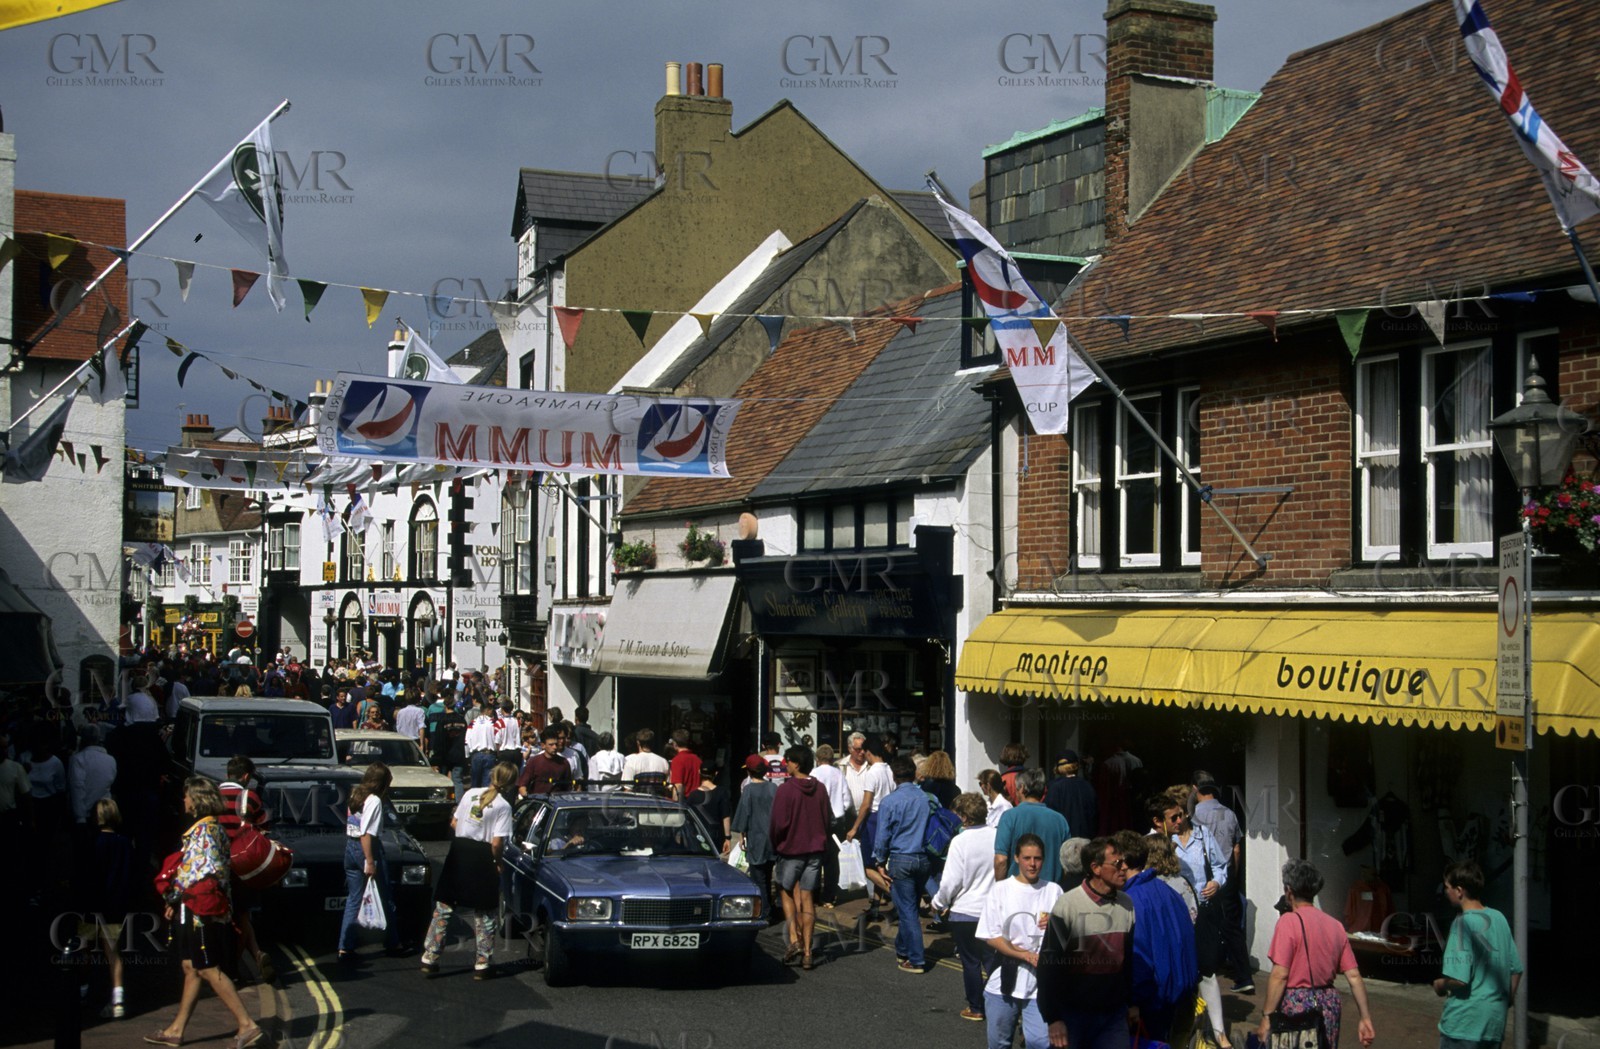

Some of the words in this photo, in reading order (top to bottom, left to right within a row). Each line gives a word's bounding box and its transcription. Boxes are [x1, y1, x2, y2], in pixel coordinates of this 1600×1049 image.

[1026, 402, 1058, 414] CUP
[132, 483, 173, 491] WHITBREAD
[1503, 551, 1519, 569] ZONE
[377, 602, 400, 614] MUMM
[661, 641, 669, 656] &
[669, 641, 690, 658] SONS
[1016, 650, 1108, 684] mantrap
[1277, 656, 1428, 701] boutique
[633, 935, 660, 947] RPX
[662, 935, 698, 947] 682S
